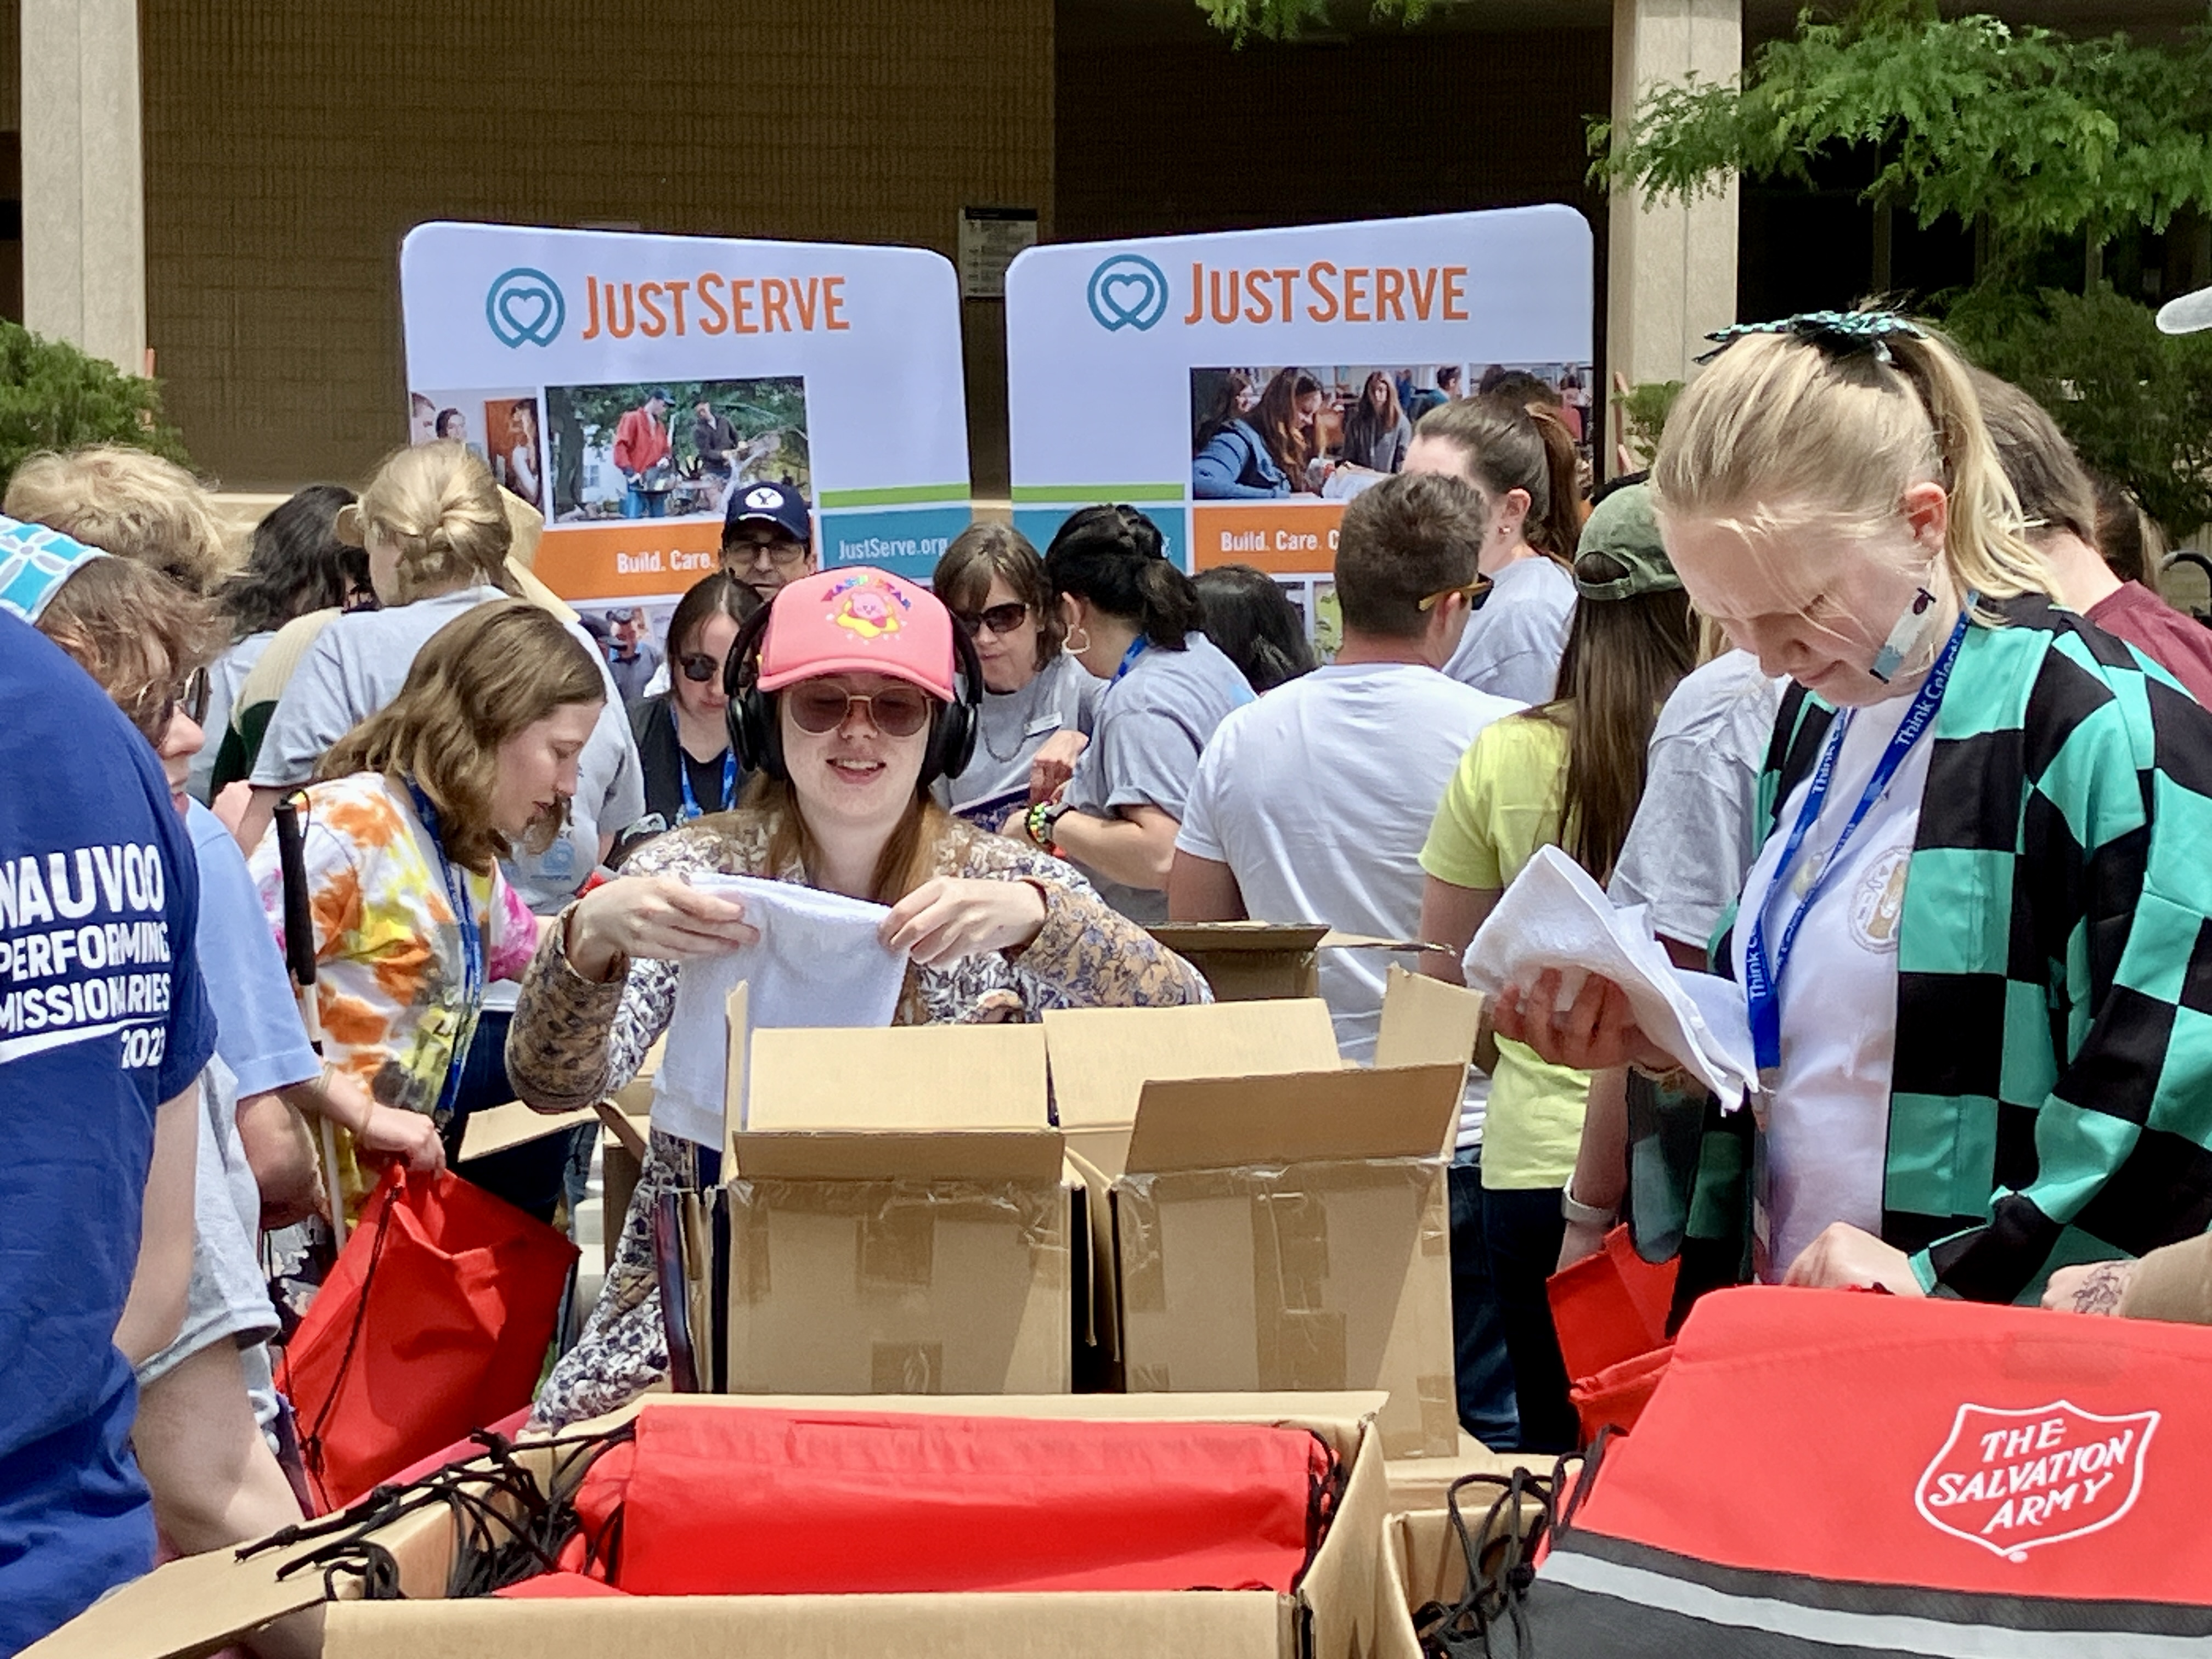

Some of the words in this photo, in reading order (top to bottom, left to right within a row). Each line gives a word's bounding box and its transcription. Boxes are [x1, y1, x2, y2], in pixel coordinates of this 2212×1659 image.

[617, 550, 667, 574] Build.
[670, 549, 715, 571] Care.
[838, 537, 949, 560] JustServe.org
[1221, 531, 1270, 551] Build.
[1276, 530, 1322, 551] Care.
[1894, 699, 1935, 746] Think
[0, 843, 165, 931] NAUVOO
[1746, 951, 1767, 1003] Think
[121, 1026, 166, 1069] 202
[1980, 1418, 2067, 1463] THE
[1928, 1429, 2134, 1507] SALVATION
[1980, 1471, 2114, 1534] ARMY
